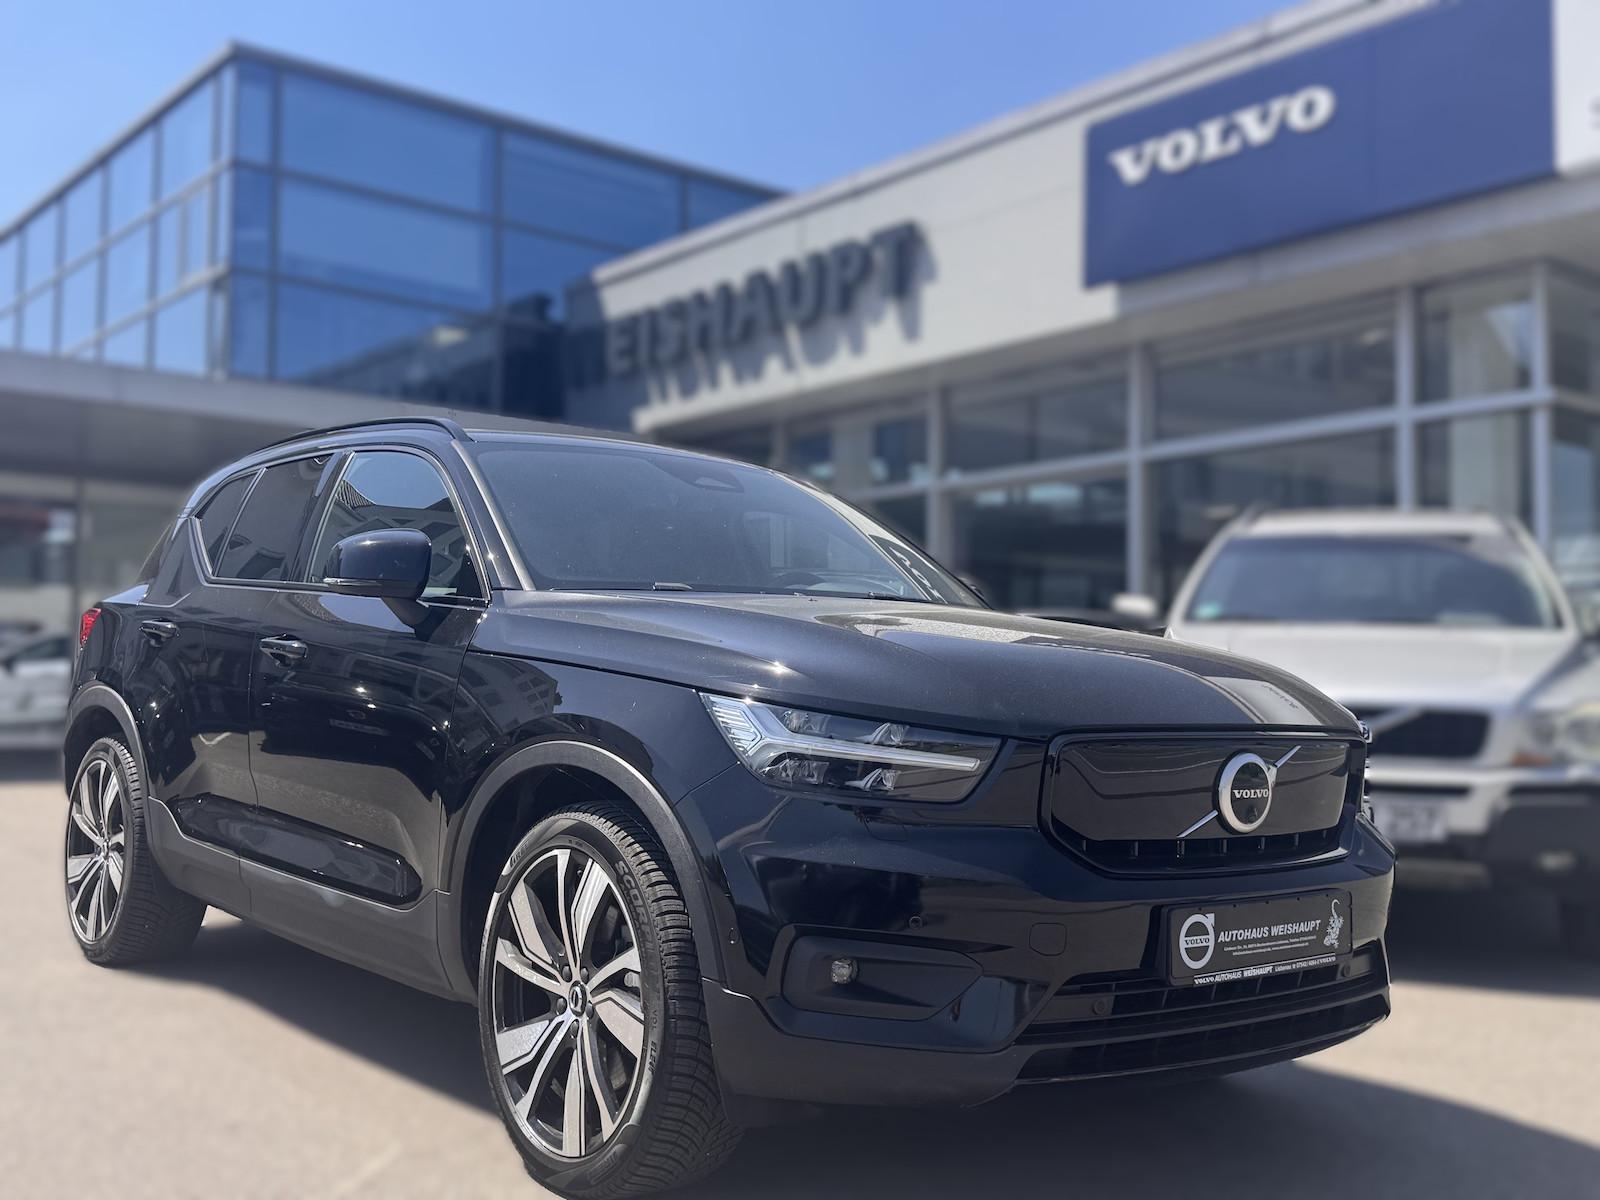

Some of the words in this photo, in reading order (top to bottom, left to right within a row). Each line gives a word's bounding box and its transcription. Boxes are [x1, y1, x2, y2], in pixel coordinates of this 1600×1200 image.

[1108, 85, 1336, 186] VOLVO
[570, 220, 922, 388] EISHAUPT
[1232, 788, 1270, 799] VOLVO
[1184, 936, 1210, 946] VOLVO
[1217, 926, 1270, 943] AUTOHAUS
[1270, 919, 1322, 938] WEISHAUPT
[1214, 971, 1242, 983] AUTOHAUS
[1243, 965, 1274, 978] WEISHAUPT
